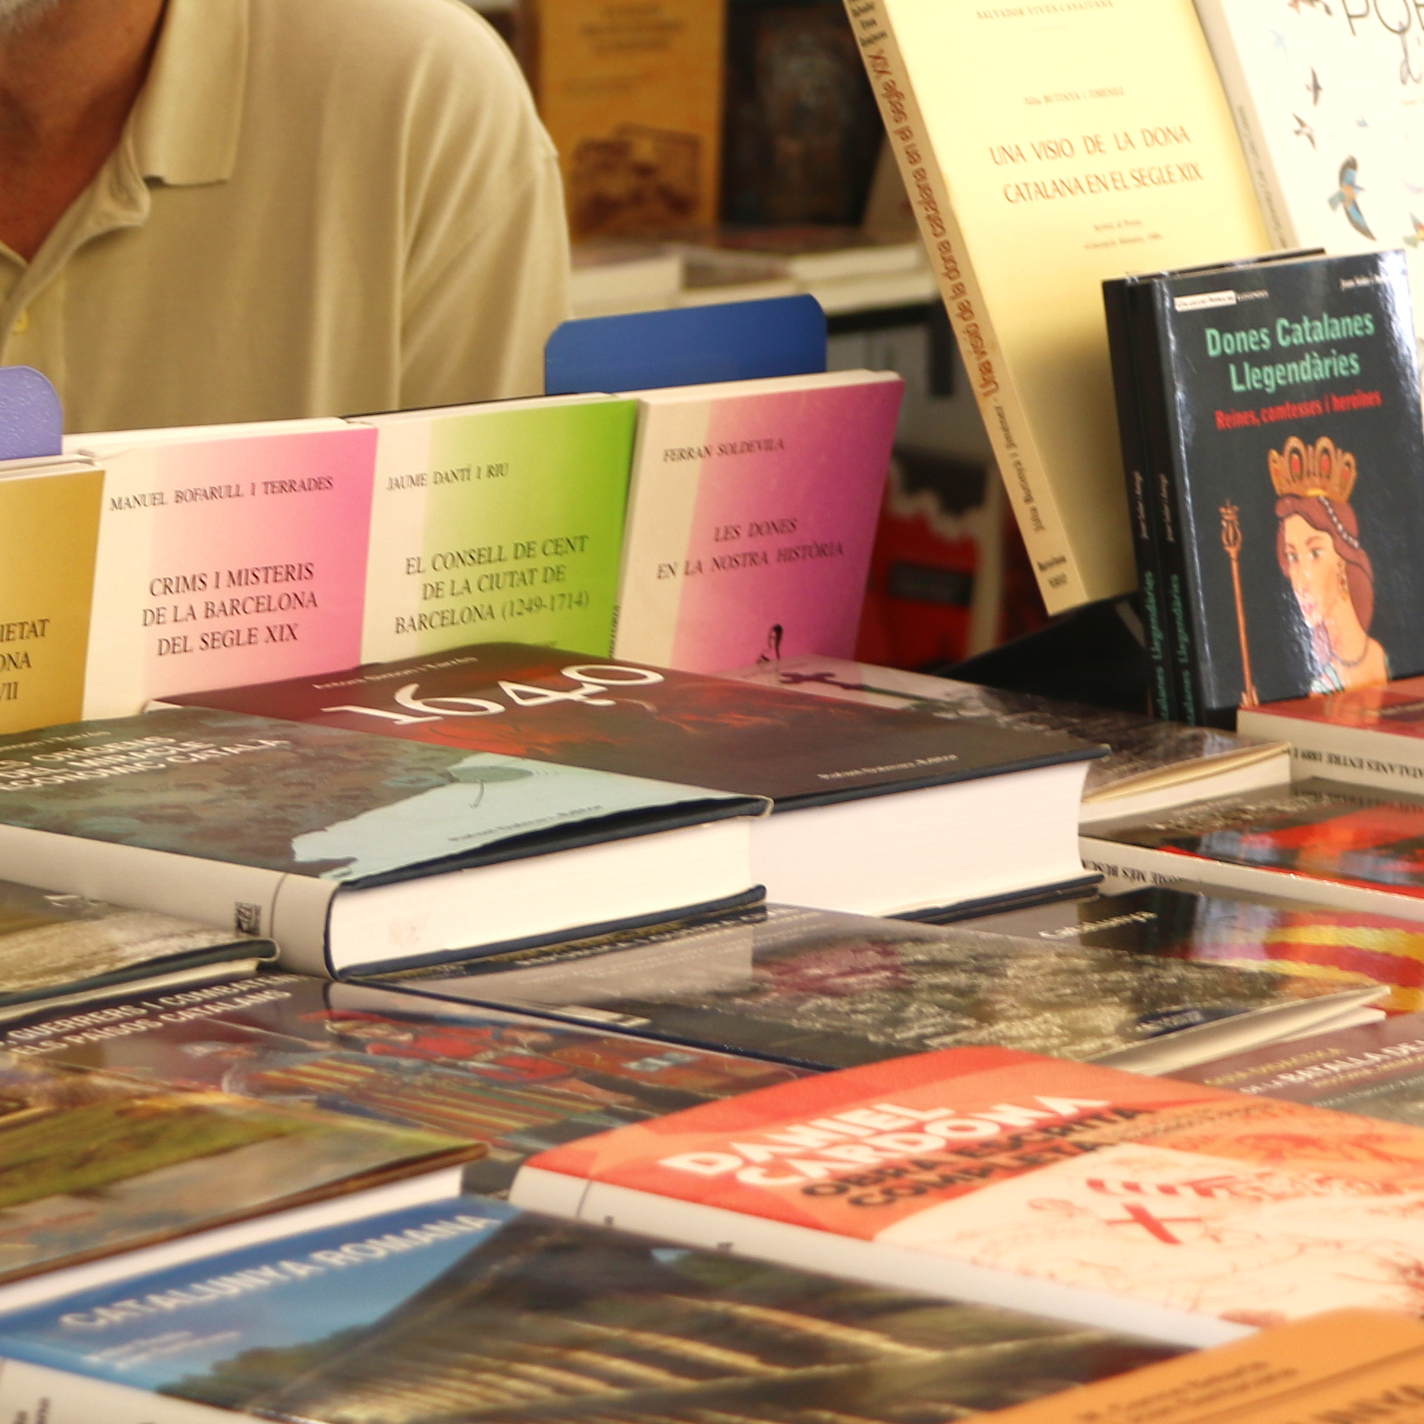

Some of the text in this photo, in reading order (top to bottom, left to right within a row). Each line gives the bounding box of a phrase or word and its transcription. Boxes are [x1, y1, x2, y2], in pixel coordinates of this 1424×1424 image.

[867, 49, 893, 78] XIX
[881, 78, 909, 126] segle
[893, 123, 915, 144] el
[988, 143, 1028, 167] UNA
[1080, 133, 1108, 156] DE
[1112, 130, 1137, 152] LA
[1140, 123, 1192, 149] DONA
[904, 142, 923, 167] en
[1002, 161, 1205, 205] CATALANA EN EL SEGLE XIX
[913, 168, 947, 240] catalana
[938, 240, 963, 283] dona
[950, 280, 968, 301] la
[956, 298, 975, 322] de
[1205, 311, 1375, 358] Dones Catalanes
[1229, 349, 1361, 394] Llegendàries
[663, 437, 785, 464] FERRAN SOLDEVILA
[109, 491, 168, 512] MANUEL
[173, 483, 245, 505] BOFARULL
[261, 476, 334, 496] TERRADES
[386, 472, 428, 491] JAUME
[486, 462, 509, 479] RIU
[714, 517, 798, 543] LES DONES
[405, 534, 589, 576] EL CONSELL DE CENT
[656, 538, 845, 581] EN LA NOSTRA HISTÒRIA
[148, 572, 208, 597] CRIMS
[226, 561, 315, 589] MISTERIS
[421, 563, 566, 602] DE LA CIUTAT DE
[142, 590, 319, 627] DE LA BARCELONA
[394, 602, 496, 635] BARCELONA
[156, 623, 299, 656] DEL SEGLE XIX
[321, 663, 665, 726] 1640
[657, 1102, 958, 1175] DANIEL
[735, 1094, 1113, 1187] CARDONA
[847, 1134, 1120, 1208] COMPLETA
[58, 1258, 330, 1329] CATALUNYA
